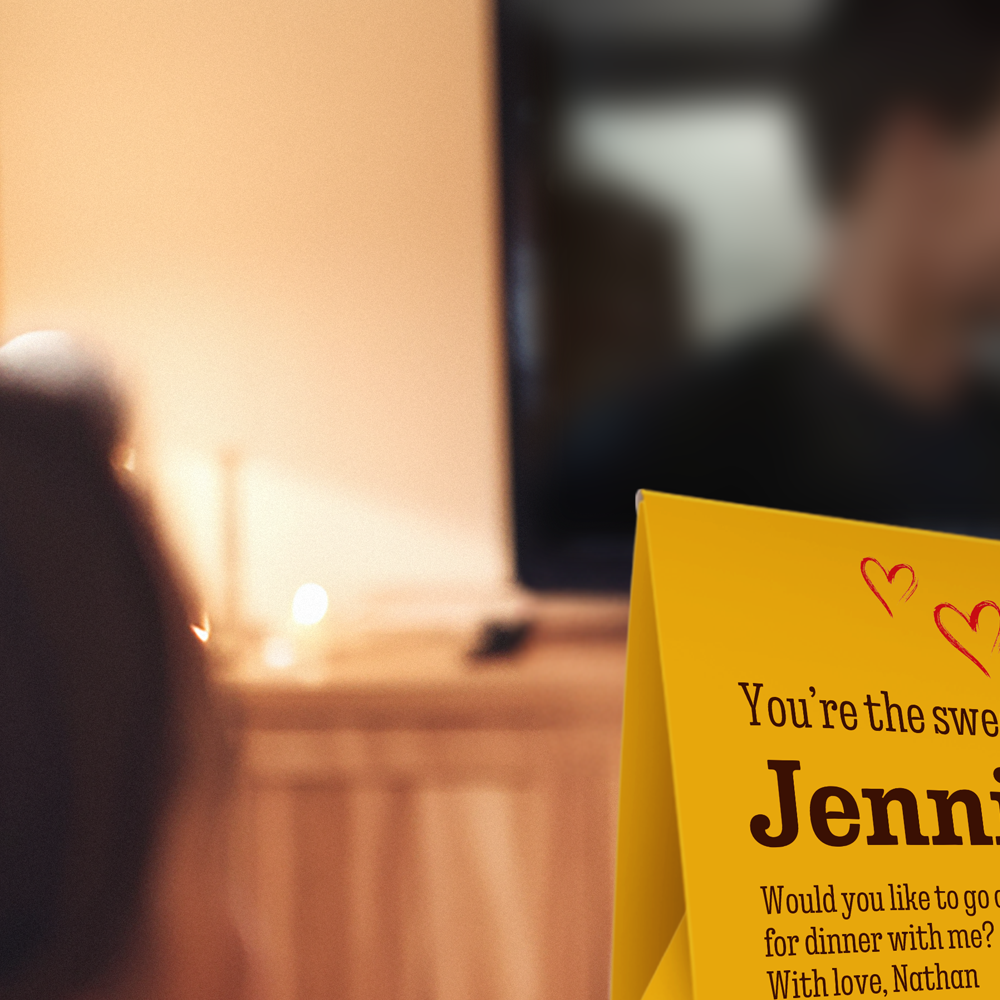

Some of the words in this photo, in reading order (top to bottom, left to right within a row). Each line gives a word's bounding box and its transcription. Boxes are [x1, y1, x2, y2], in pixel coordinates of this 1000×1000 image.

[737, 681, 858, 731] You’re
[863, 690, 925, 734] the
[759, 884, 838, 915] Would
[840, 891, 886, 920] you
[887, 883, 931, 911] like
[933, 885, 959, 910] to
[963, 889, 990, 917] go
[763, 927, 800, 958] for
[804, 926, 883, 956] dinner
[886, 922, 945, 952] with
[946, 920, 995, 949] me?
[766, 968, 829, 1000] With
[831, 967, 888, 997] love,
[891, 962, 980, 993] Nathan
